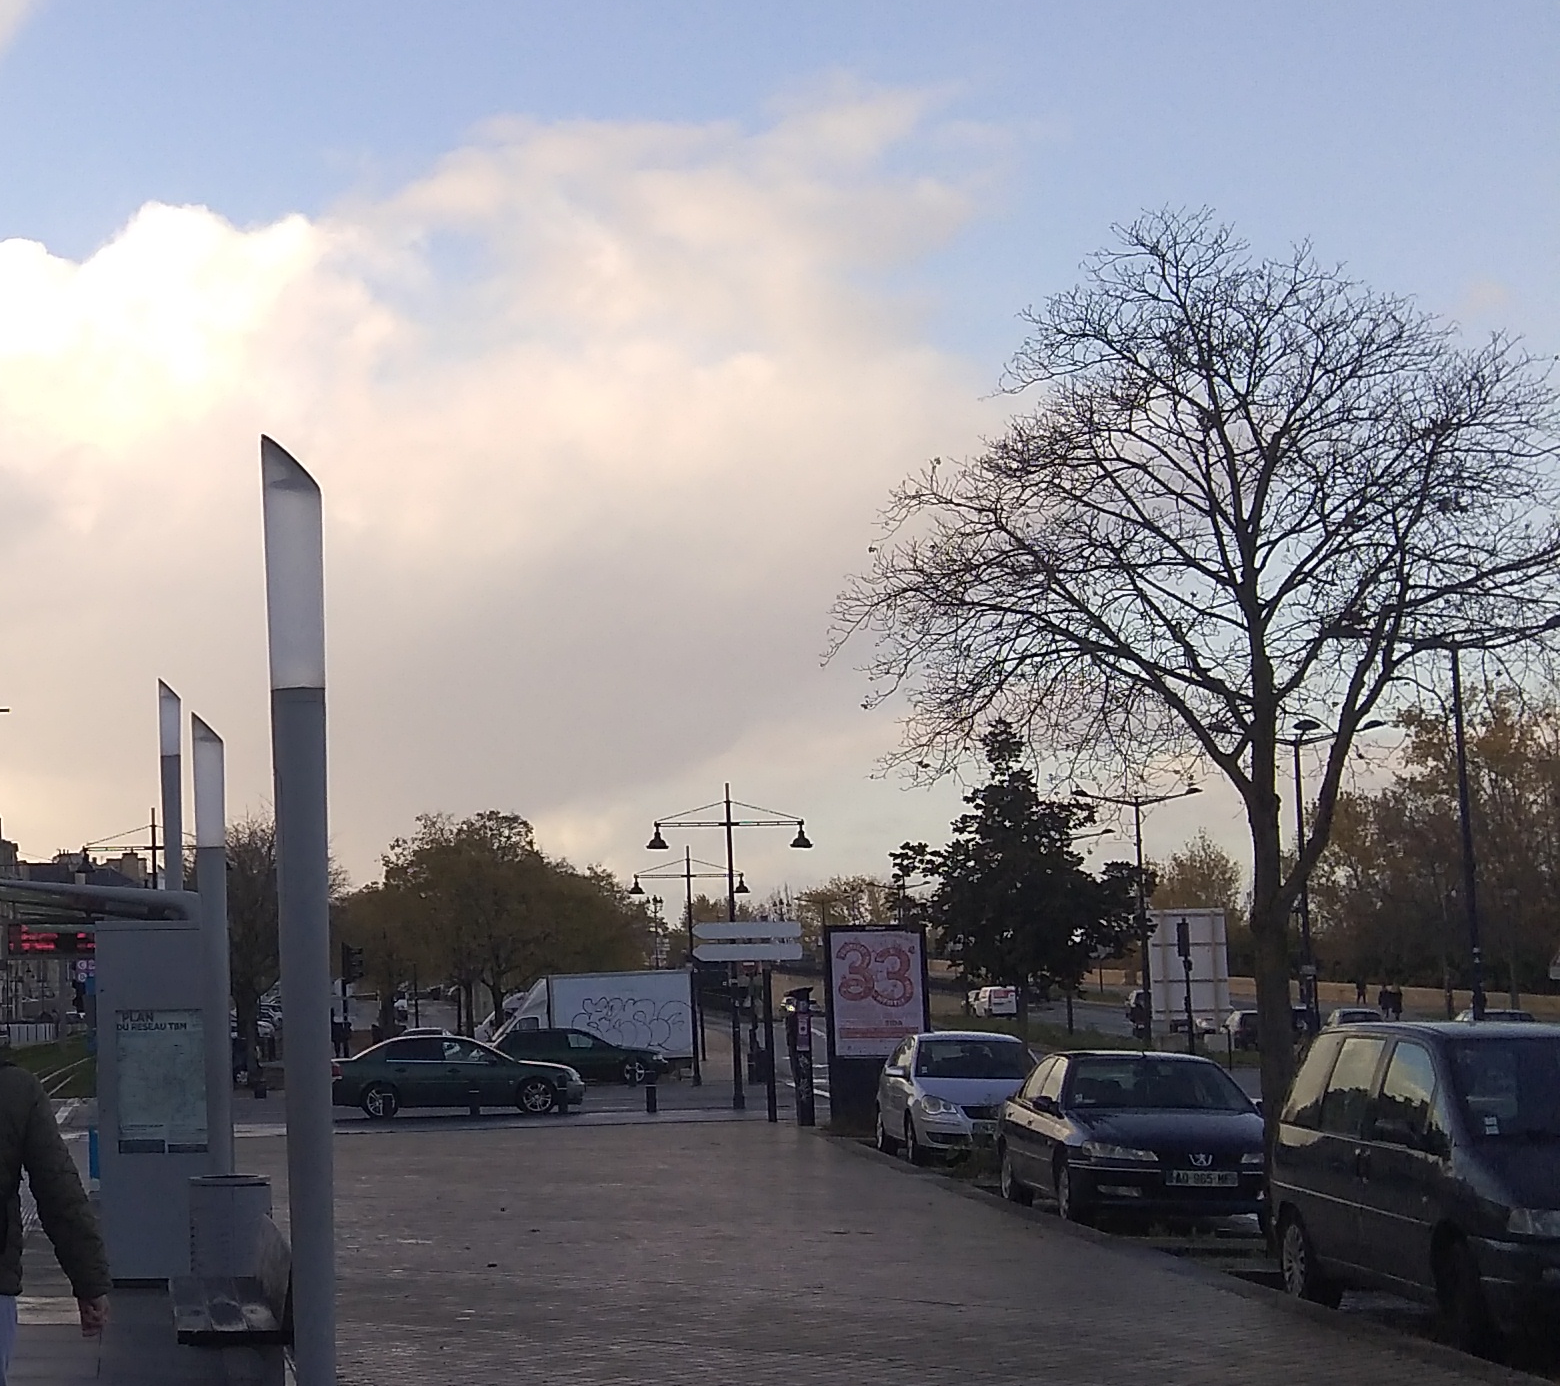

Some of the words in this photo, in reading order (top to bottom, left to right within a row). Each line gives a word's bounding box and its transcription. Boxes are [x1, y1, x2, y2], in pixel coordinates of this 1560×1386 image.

[122, 1012, 154, 1022] PLAN
[116, 1023, 129, 1031] DU
[169, 1022, 187, 1030] TBM
